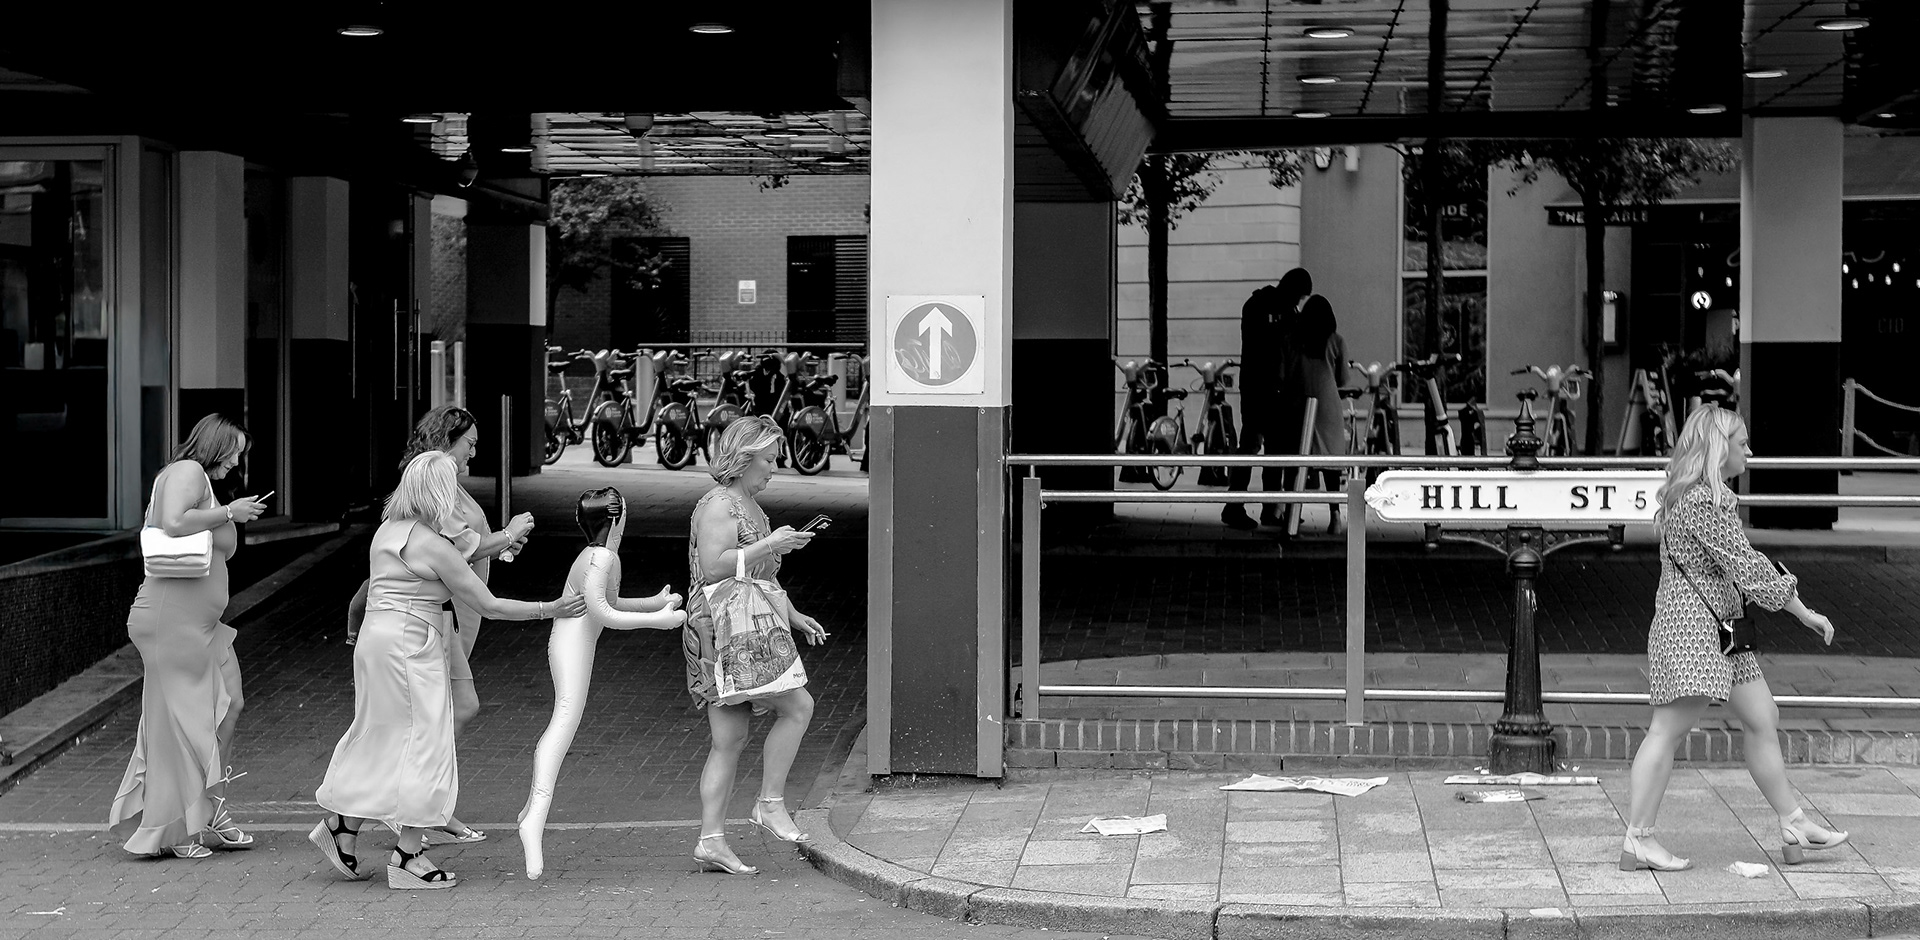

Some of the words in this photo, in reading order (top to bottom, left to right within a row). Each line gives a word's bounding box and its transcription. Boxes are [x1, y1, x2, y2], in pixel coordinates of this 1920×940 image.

[1556, 210, 1585, 224] THE
[1604, 209, 1649, 223] ABLE
[1420, 484, 1518, 510] HILL
[1570, 485, 1617, 510] ST
[1634, 491, 1647, 510] 5
